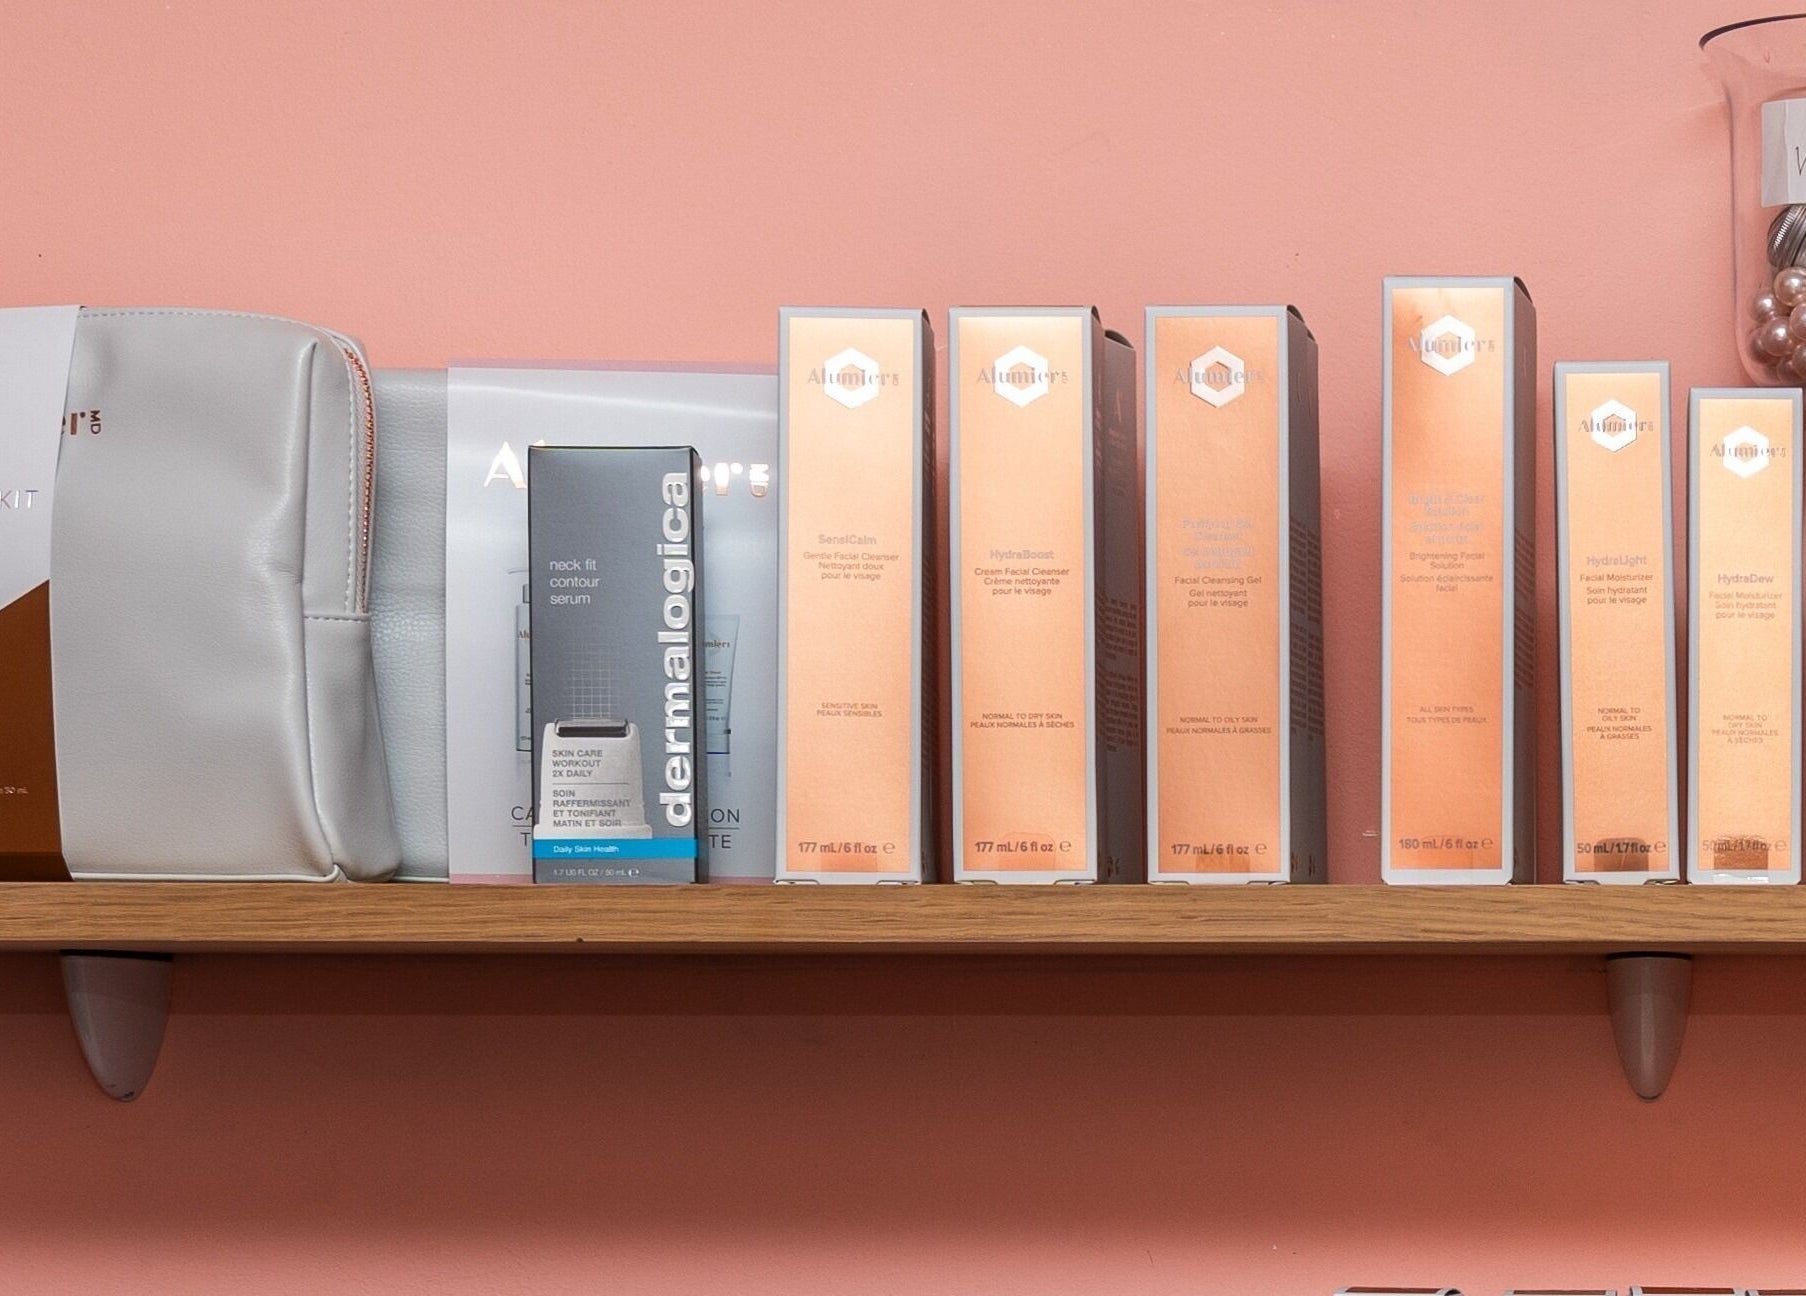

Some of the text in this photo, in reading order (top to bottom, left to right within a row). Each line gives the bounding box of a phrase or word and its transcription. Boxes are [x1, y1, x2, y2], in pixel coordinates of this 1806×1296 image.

[550, 559, 597, 570] neck fit
[974, 567, 1070, 576] Cream Facial Cleanser
[550, 578, 600, 587] contour
[1718, 573, 1774, 586] HydraDew
[550, 595, 590, 604] serum
[657, 472, 694, 827] dermalogica
